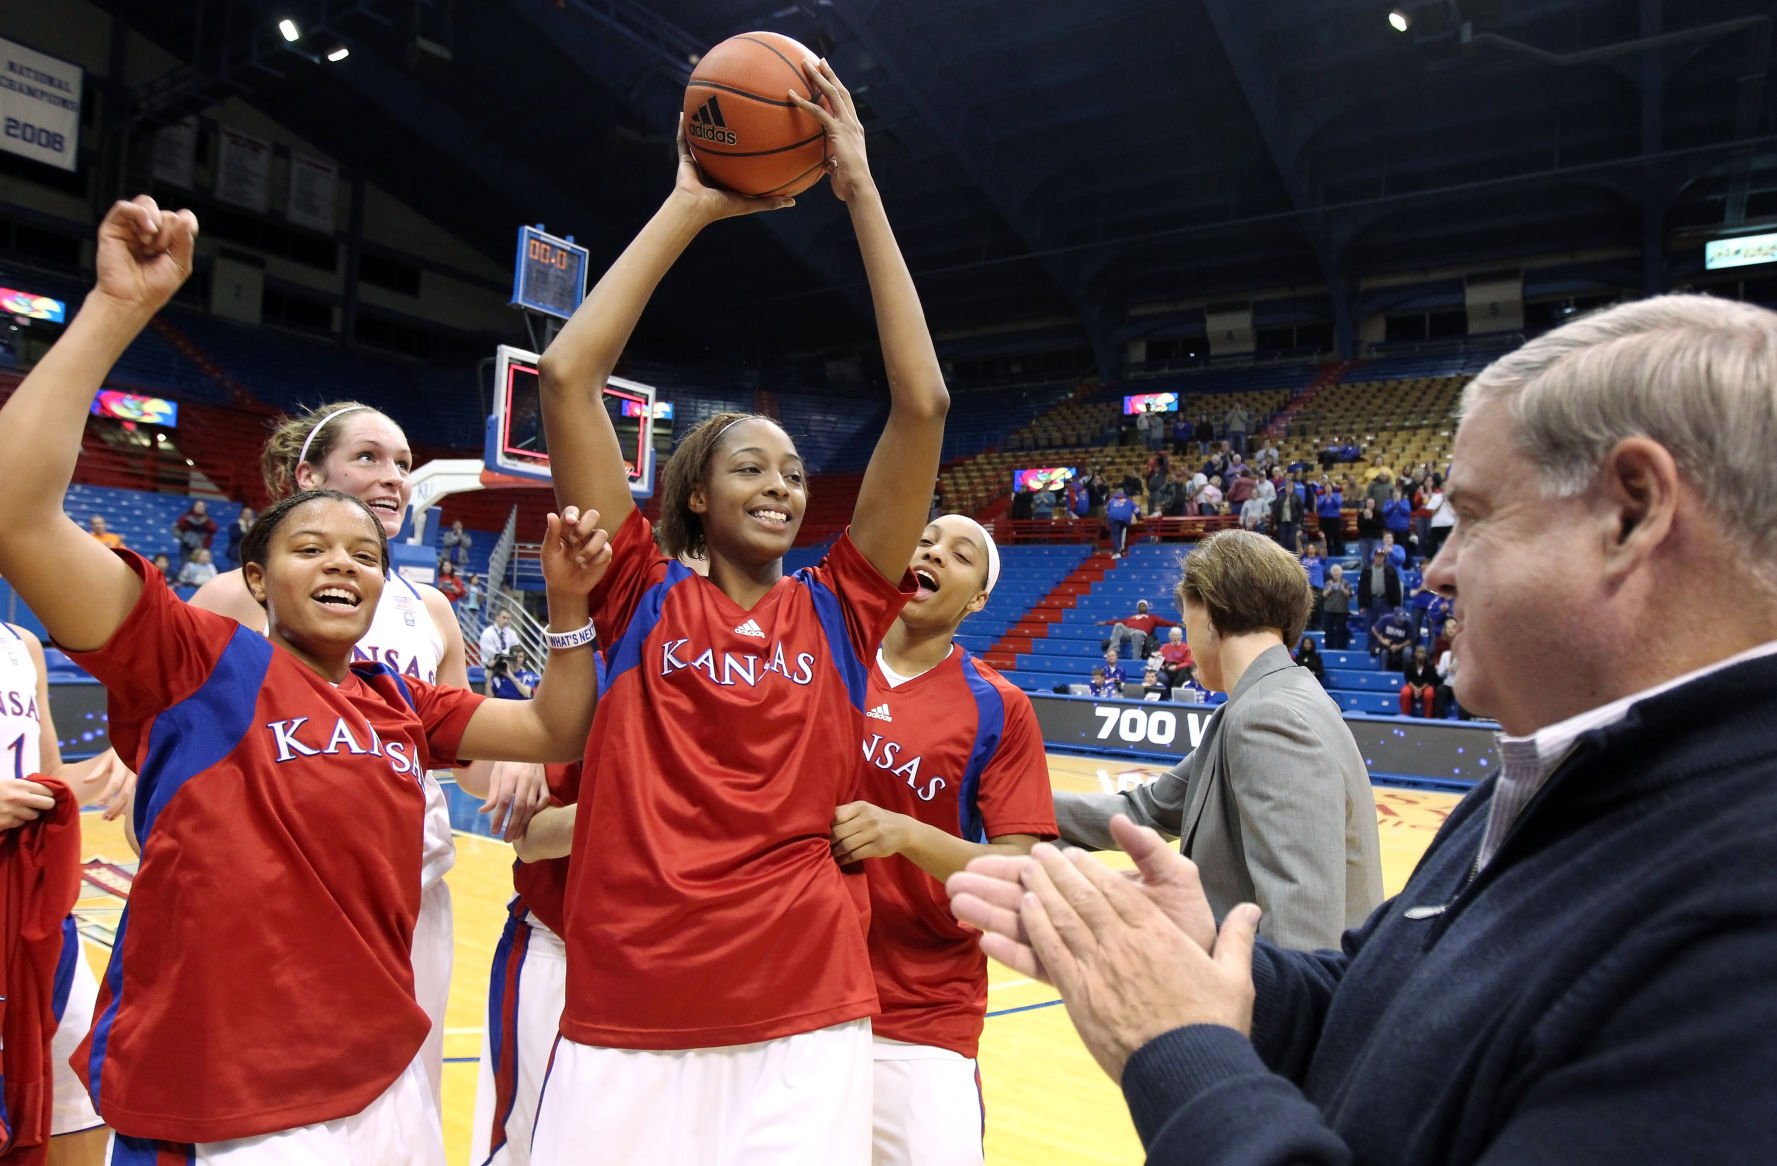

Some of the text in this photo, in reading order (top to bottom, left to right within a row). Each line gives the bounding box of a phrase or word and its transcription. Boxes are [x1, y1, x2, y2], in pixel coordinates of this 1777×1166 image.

[7, 61, 73, 94] NATIONAL
[5, 117, 64, 153] 2008
[689, 124, 736, 145] adidas
[549, 634, 579, 647] WHAT'S
[1095, 706, 1177, 745] 700
[266, 717, 427, 792] KASA
